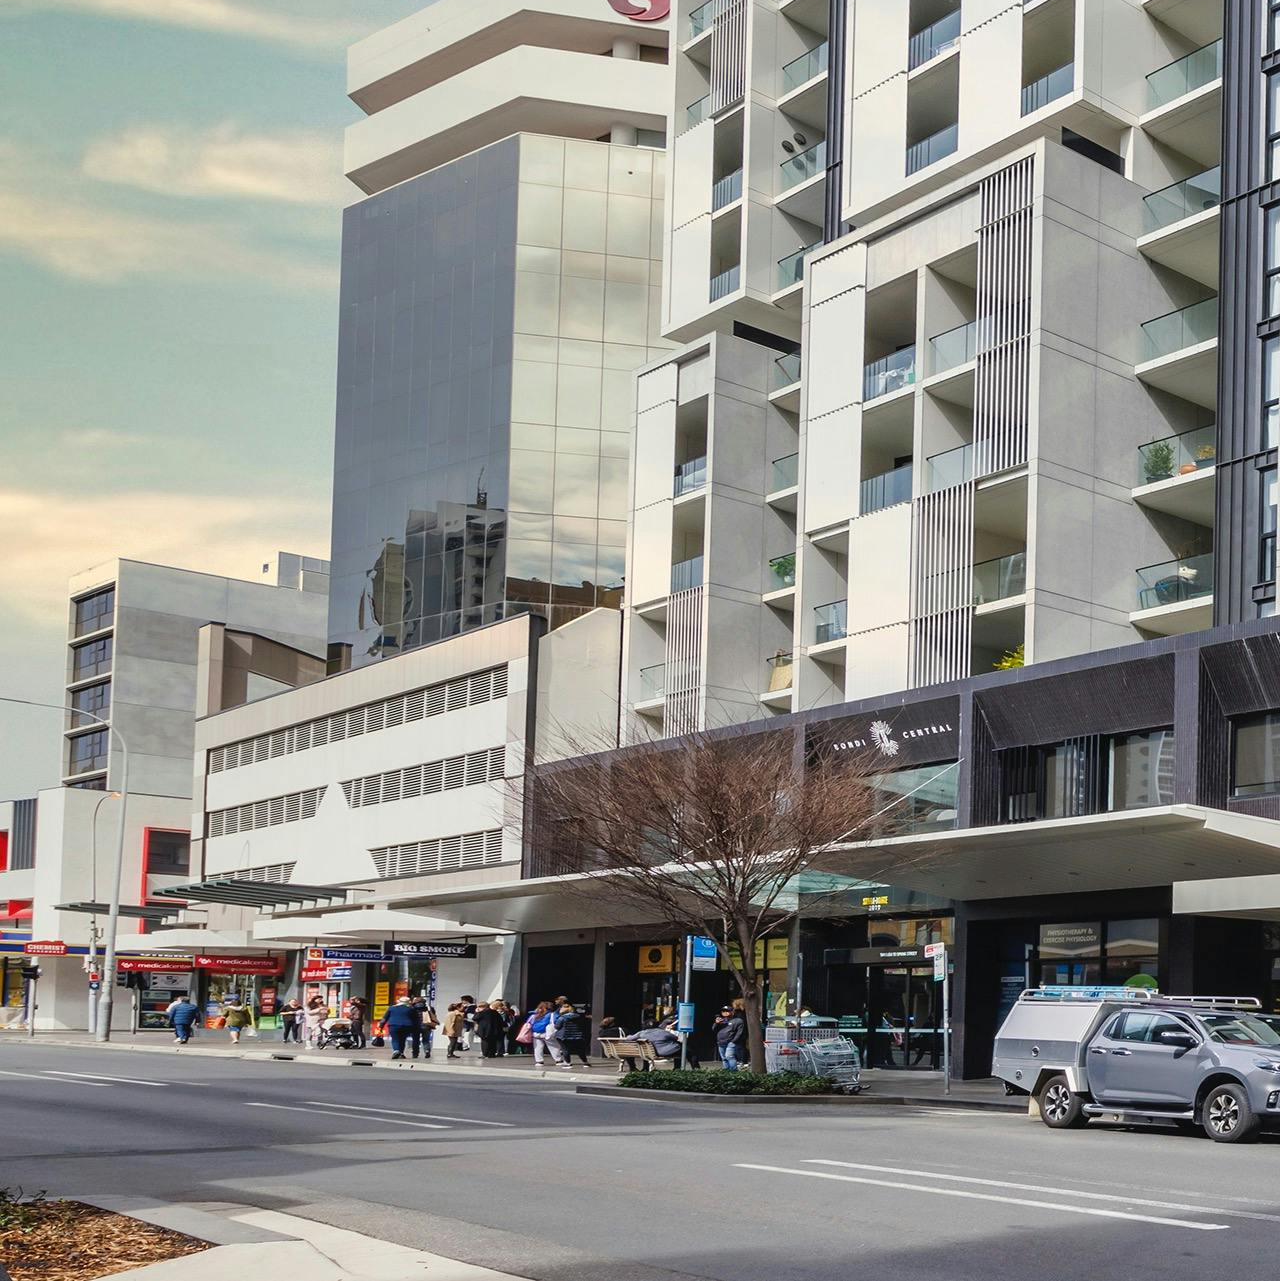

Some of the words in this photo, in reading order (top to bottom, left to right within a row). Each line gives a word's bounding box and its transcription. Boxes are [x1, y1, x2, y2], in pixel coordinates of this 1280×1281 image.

[833, 739, 866, 751] BONDI
[902, 724, 953, 739] CENTRAL
[1065, 935, 1098, 943] PHYSIOLOGY
[394, 944, 418, 952] BIG
[420, 945, 466, 954] SMOKE
[327, 950, 385, 960] Pharmacy
